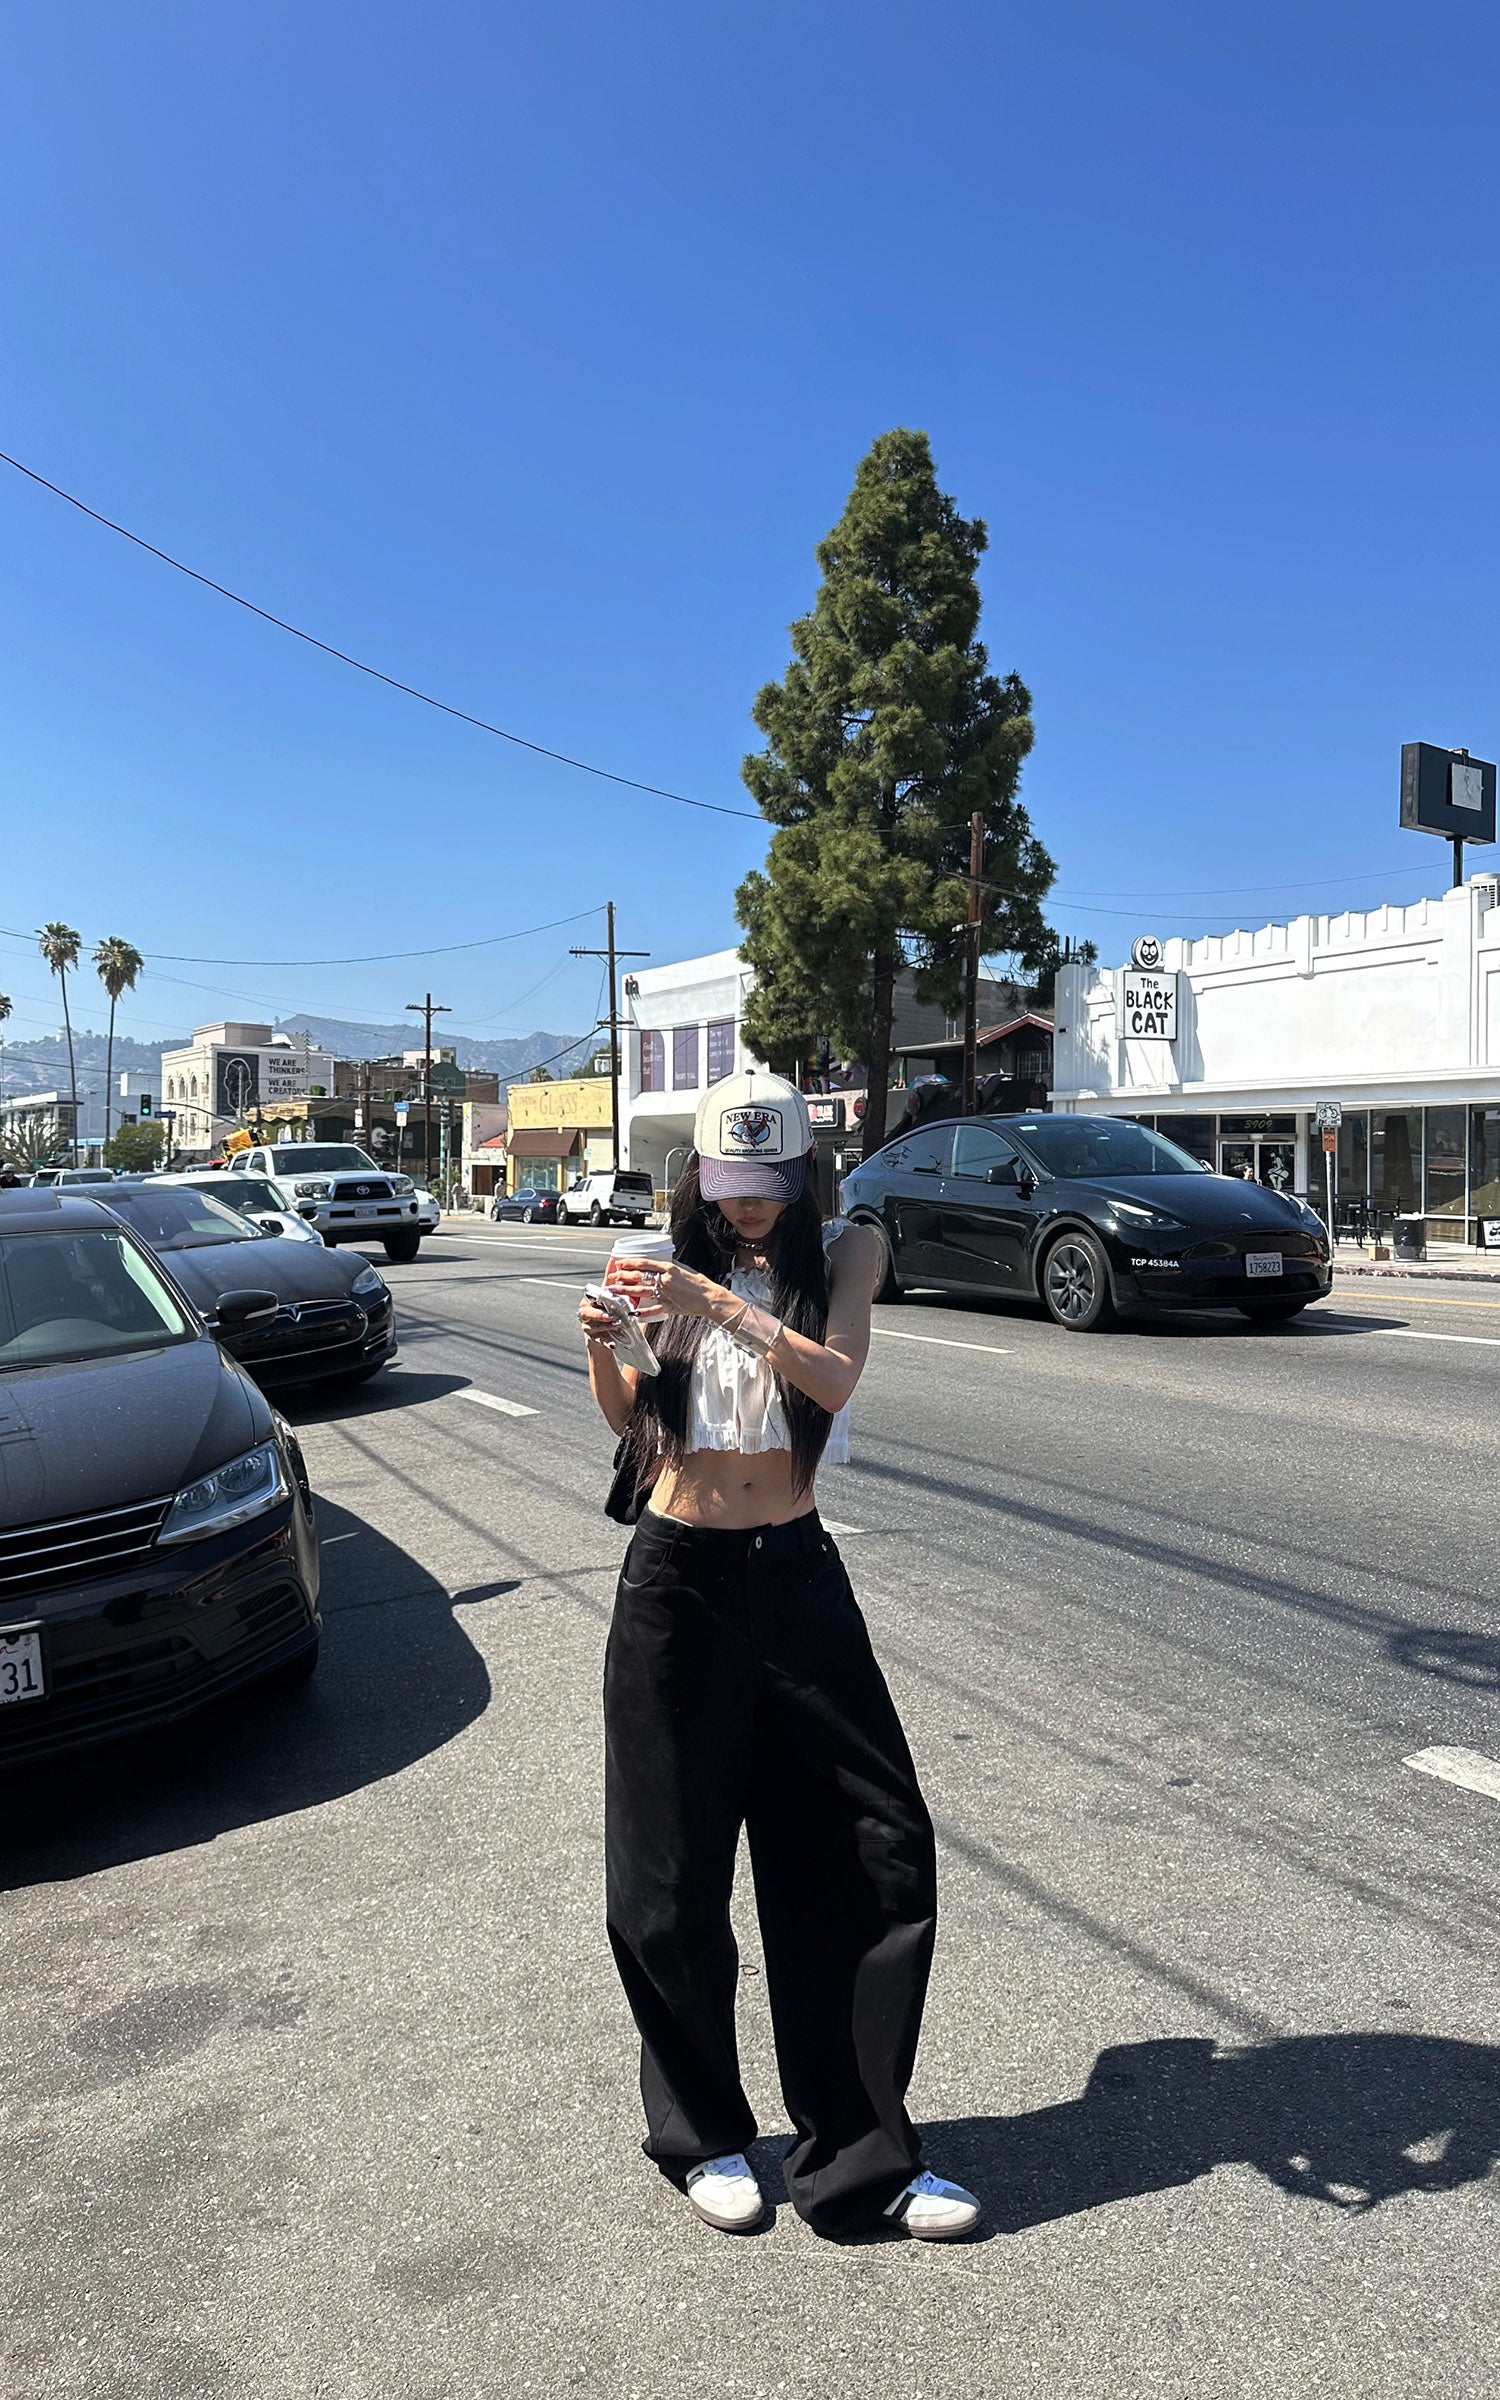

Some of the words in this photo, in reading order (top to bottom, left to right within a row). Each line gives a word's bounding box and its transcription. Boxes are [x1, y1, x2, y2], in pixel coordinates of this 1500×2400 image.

[1140, 977, 1159, 989] The
[1126, 990, 1174, 1010] BLACK
[1132, 1011, 1168, 1035] CAT
[268, 1058, 281, 1066] WE
[282, 1059, 297, 1067] ARE
[268, 1079, 280, 1087] WE
[726, 1111, 751, 1124] NEW
[754, 1111, 777, 1124] ERA
[1243, 1119, 1273, 1129] 3909
[1130, 1257, 1147, 1266] TCP
[1147, 1259, 1180, 1268] 45384A
[2, 1658, 38, 1695] 31
